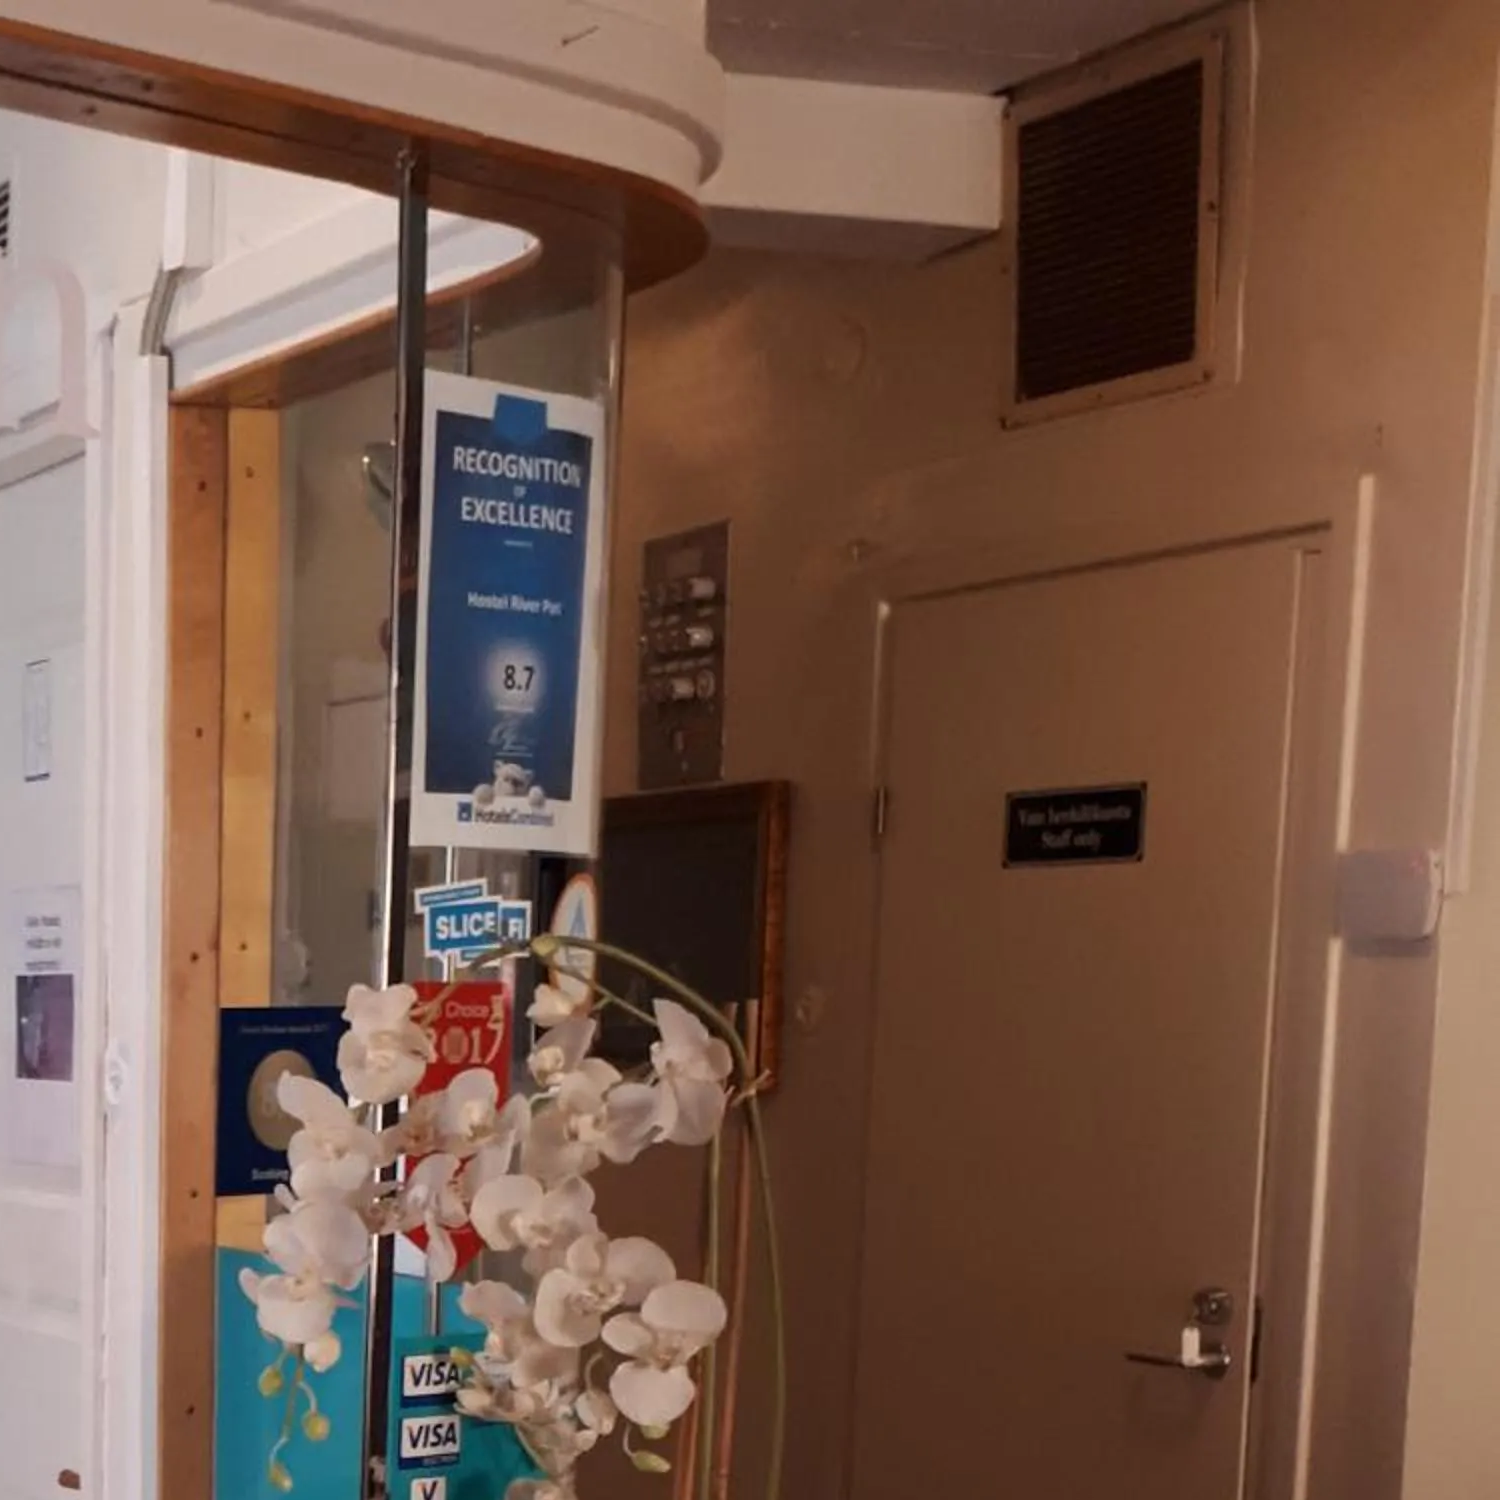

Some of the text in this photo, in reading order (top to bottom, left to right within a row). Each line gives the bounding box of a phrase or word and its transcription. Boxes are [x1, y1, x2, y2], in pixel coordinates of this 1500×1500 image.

[453, 446, 581, 488] RECOGNITION
[461, 496, 573, 535] EXCELLENCE
[503, 665, 535, 691] 8.7
[436, 911, 497, 940] SLICE
[407, 1361, 459, 1387] VISA
[406, 1421, 457, 1449] VISA
